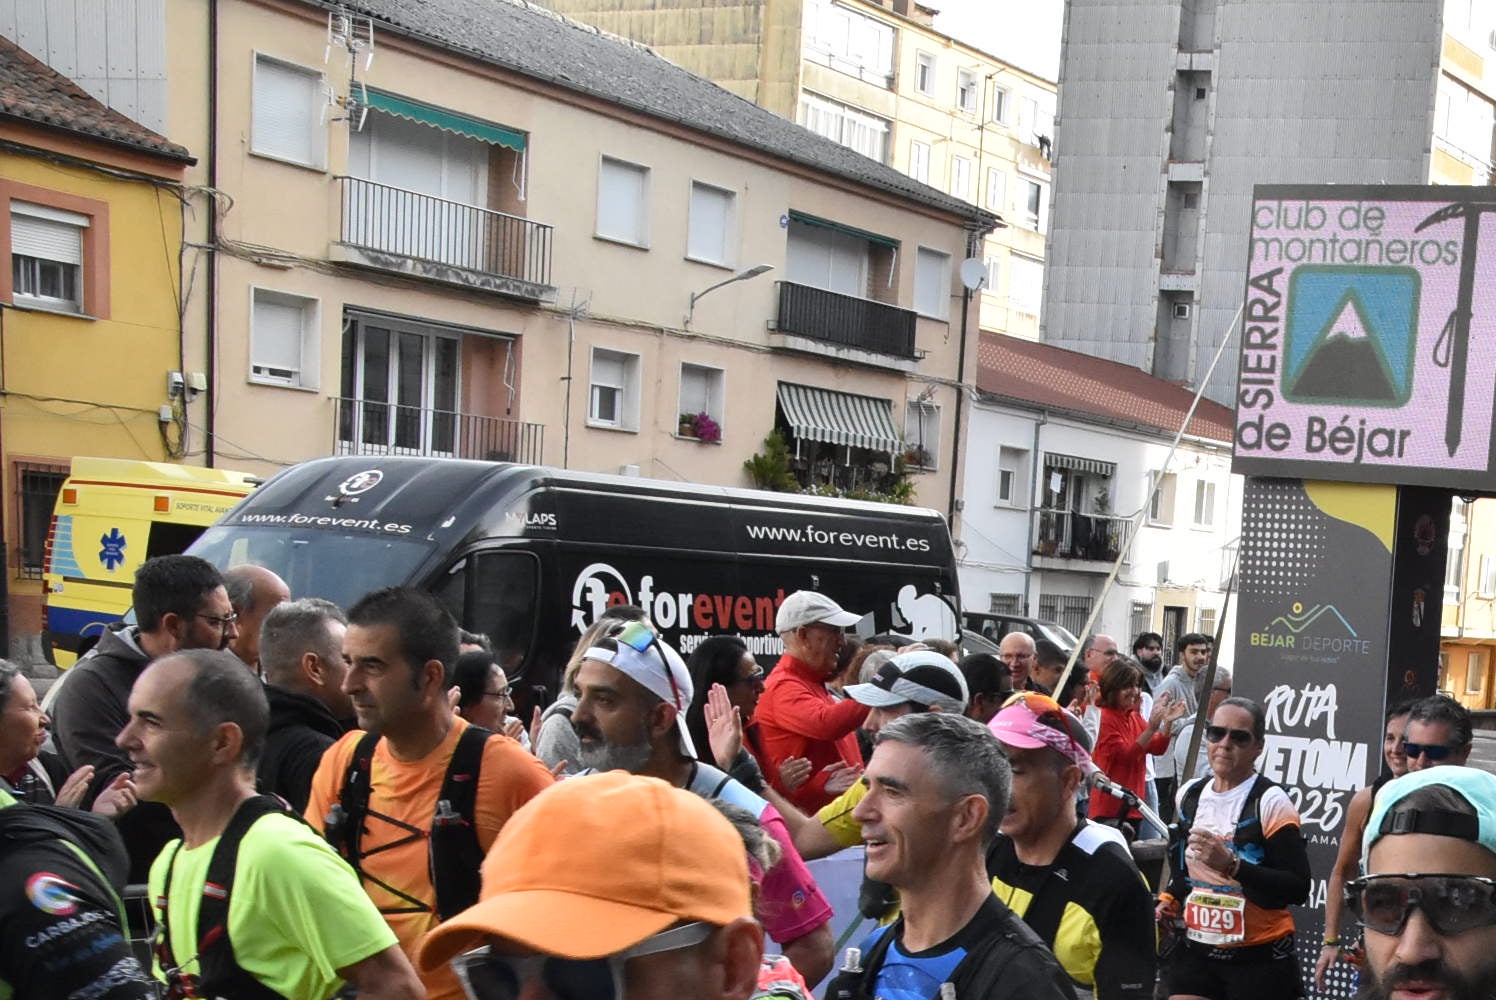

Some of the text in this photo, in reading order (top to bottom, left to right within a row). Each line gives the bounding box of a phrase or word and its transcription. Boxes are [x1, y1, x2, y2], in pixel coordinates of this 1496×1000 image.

[1254, 200, 1386, 231] club de
[1250, 231, 1460, 265] montañeros
[1240, 267, 1284, 411] SIERRA
[1237, 414, 1411, 464] de Béjar
[242, 513, 413, 533] www.forevent.es
[746, 523, 931, 552] www.forevent.es
[1250, 626, 1295, 649] BÉJAR
[1264, 682, 1338, 739] RUTA
[1191, 904, 1235, 930] 1029
